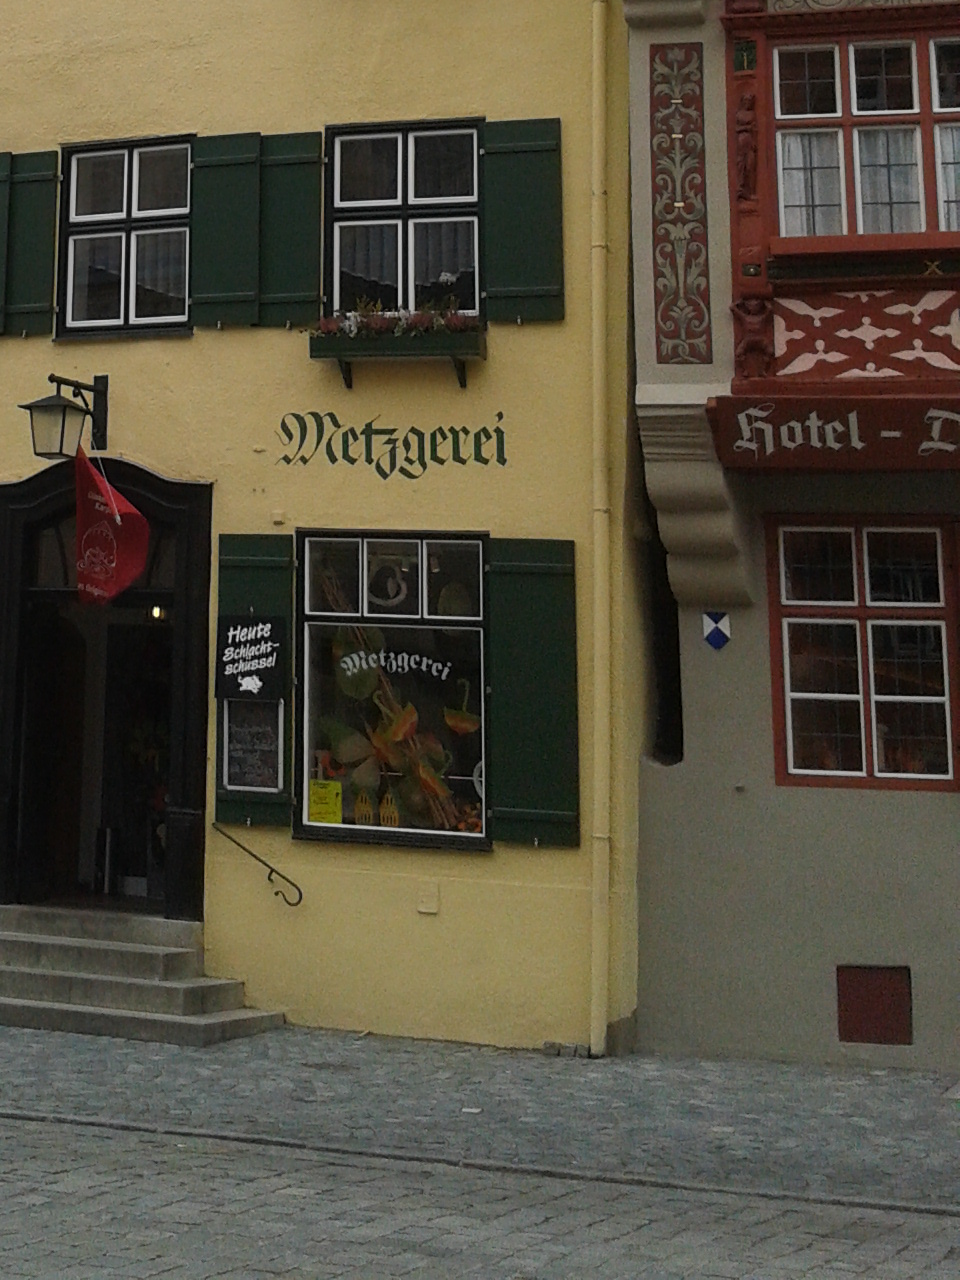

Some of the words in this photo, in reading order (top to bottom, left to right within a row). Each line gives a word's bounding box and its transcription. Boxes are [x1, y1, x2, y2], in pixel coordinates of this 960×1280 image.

[274, 410, 508, 481] Metzgerei
[733, 402, 866, 462] Hotel
[227, 622, 272, 644] Heute
[222, 640, 280, 662] Schlacht-
[340, 648, 452, 680] Metzgerei
